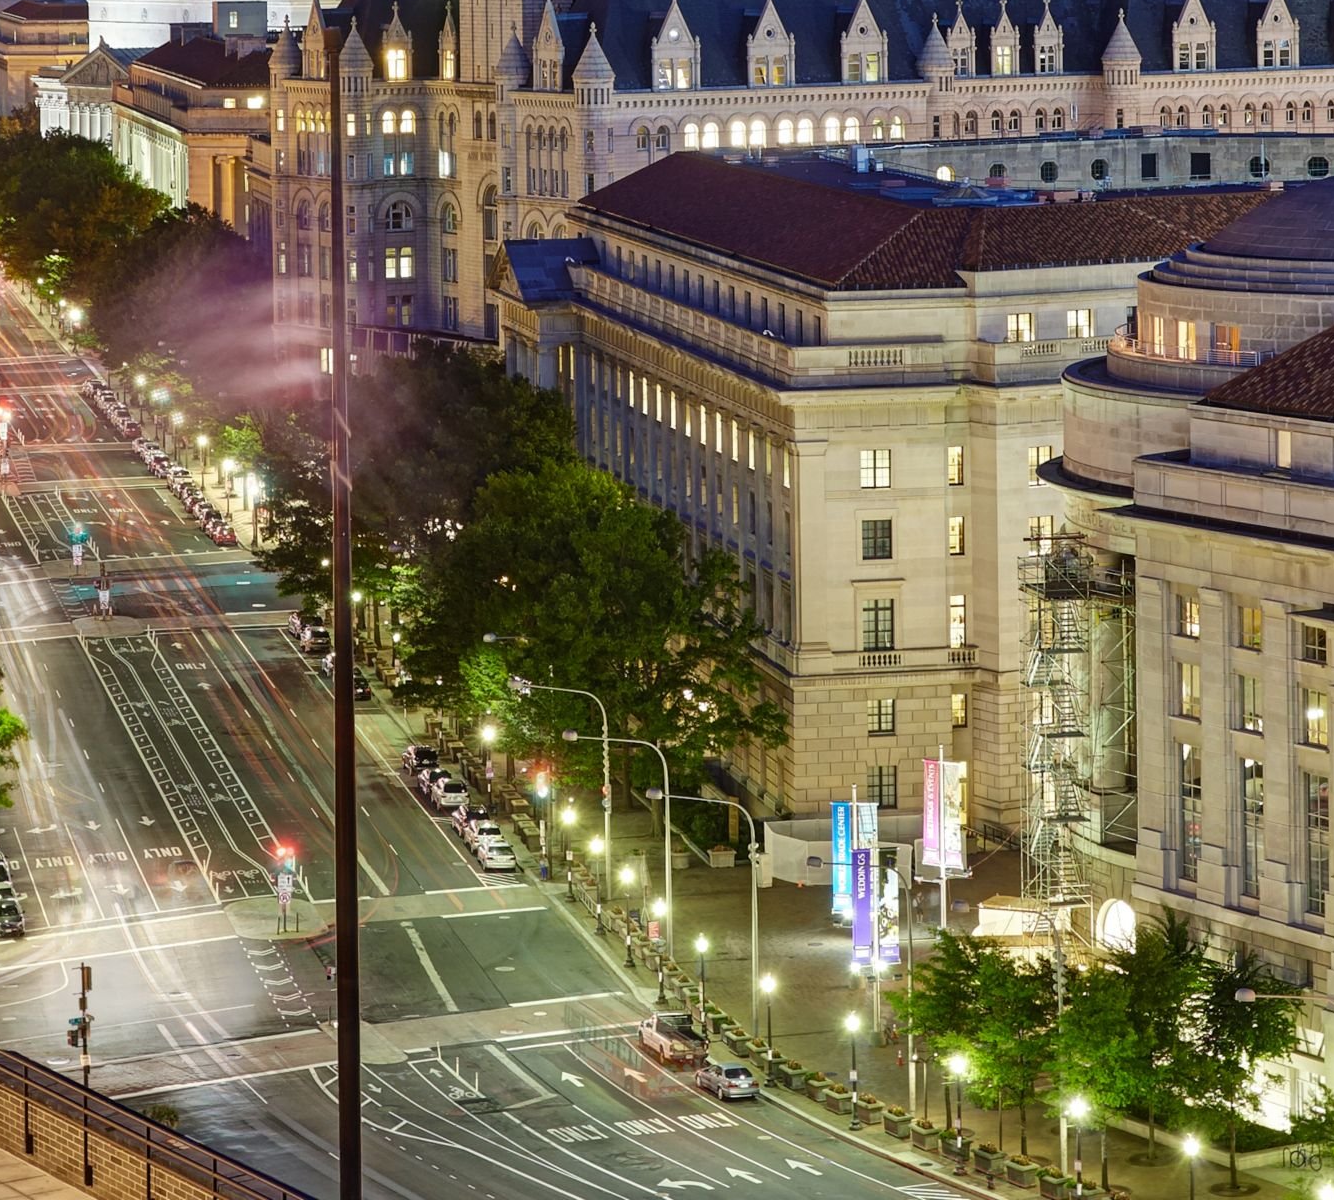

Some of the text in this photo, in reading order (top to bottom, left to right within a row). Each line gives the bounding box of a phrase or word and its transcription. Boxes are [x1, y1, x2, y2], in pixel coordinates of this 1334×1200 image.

[175, 662, 207, 670] ONLY
[837, 806, 845, 836] CENTER
[35, 855, 75, 869] ONLY
[87, 849, 129, 864] ONLY
[143, 846, 183, 859] ONLY
[857, 853, 866, 899] WEDDINGS
[614, 1117, 675, 1136] ONLY
[677, 1111, 739, 1130] ONLY
[547, 1124, 609, 1143] ONLY
